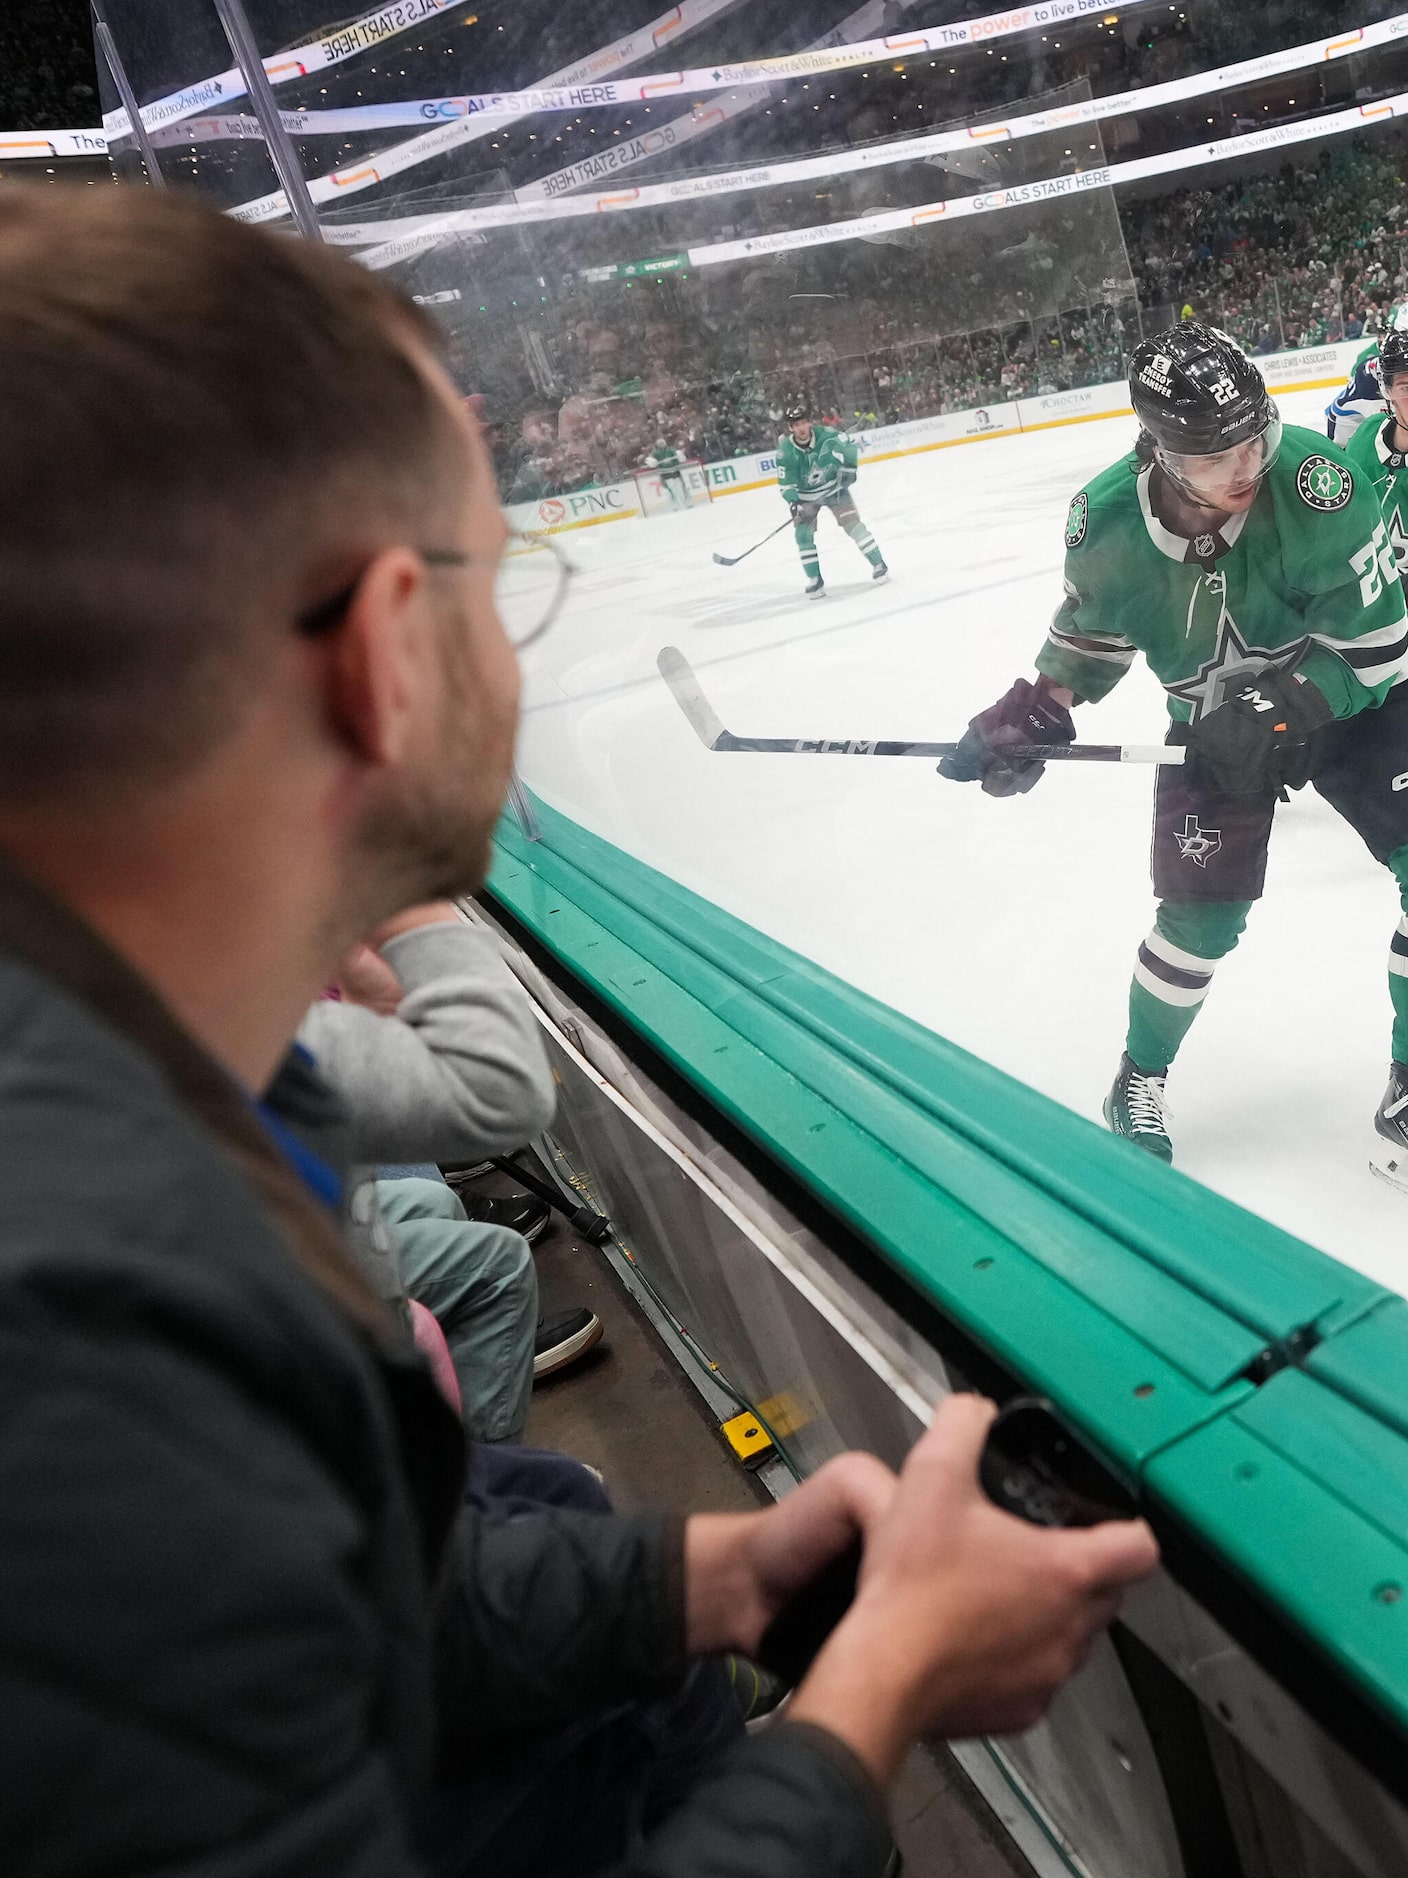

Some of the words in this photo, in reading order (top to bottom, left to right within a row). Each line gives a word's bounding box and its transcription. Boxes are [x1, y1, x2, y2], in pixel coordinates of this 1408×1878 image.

[940, 29, 967, 43] The
[970, 10, 1030, 41] power
[1035, 9, 1048, 22] to
[1051, 2, 1075, 16] live
[506, 90, 565, 112] START
[569, 85, 617, 105] HERE
[69, 134, 106, 151] The
[1033, 178, 1072, 198] START
[1076, 169, 1111, 188] HERE
[1264, 360, 1280, 371] CHRIS
[1281, 357, 1299, 369] LEWIS
[1302, 351, 1337, 364] ASSOCIATES
[1138, 372, 1173, 398] TRANSFER
[1143, 365, 1173, 385] ENERGY
[1209, 377, 1240, 406] 22
[1220, 411, 1256, 434] BAUER
[1324, 471, 1350, 507] STARS
[570, 489, 624, 516] PNC
[794, 738, 878, 755] CCM
